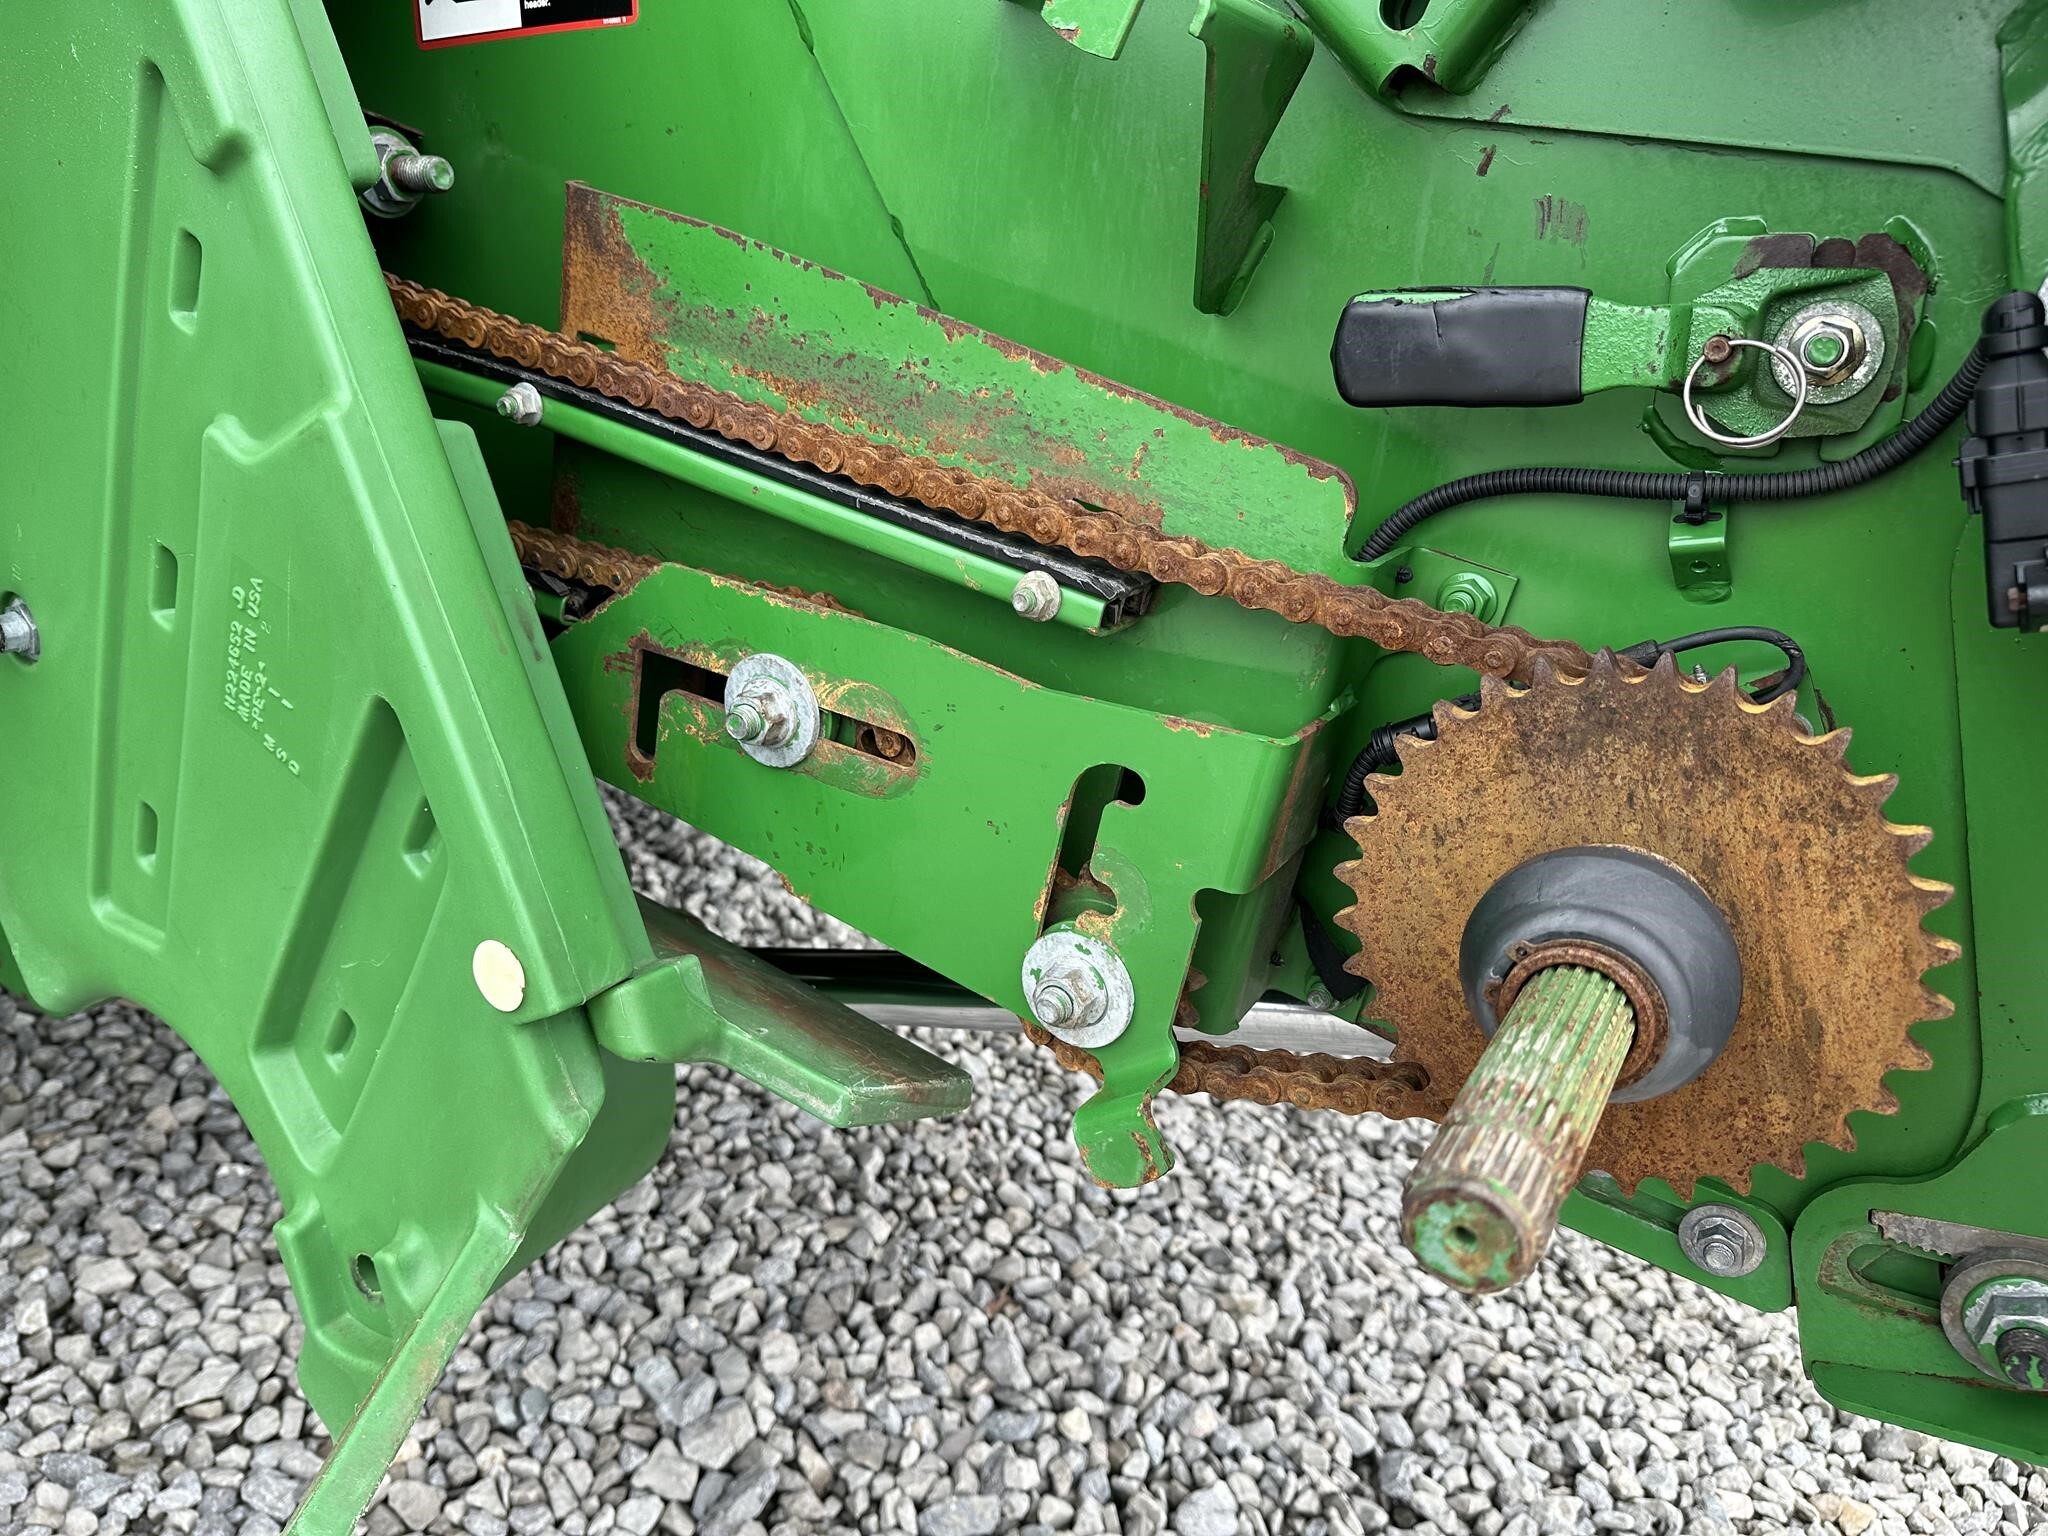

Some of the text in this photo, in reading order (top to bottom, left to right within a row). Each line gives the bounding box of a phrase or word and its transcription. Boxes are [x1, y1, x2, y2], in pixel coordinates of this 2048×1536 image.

[237, 578, 264, 722] MADE IN USA
